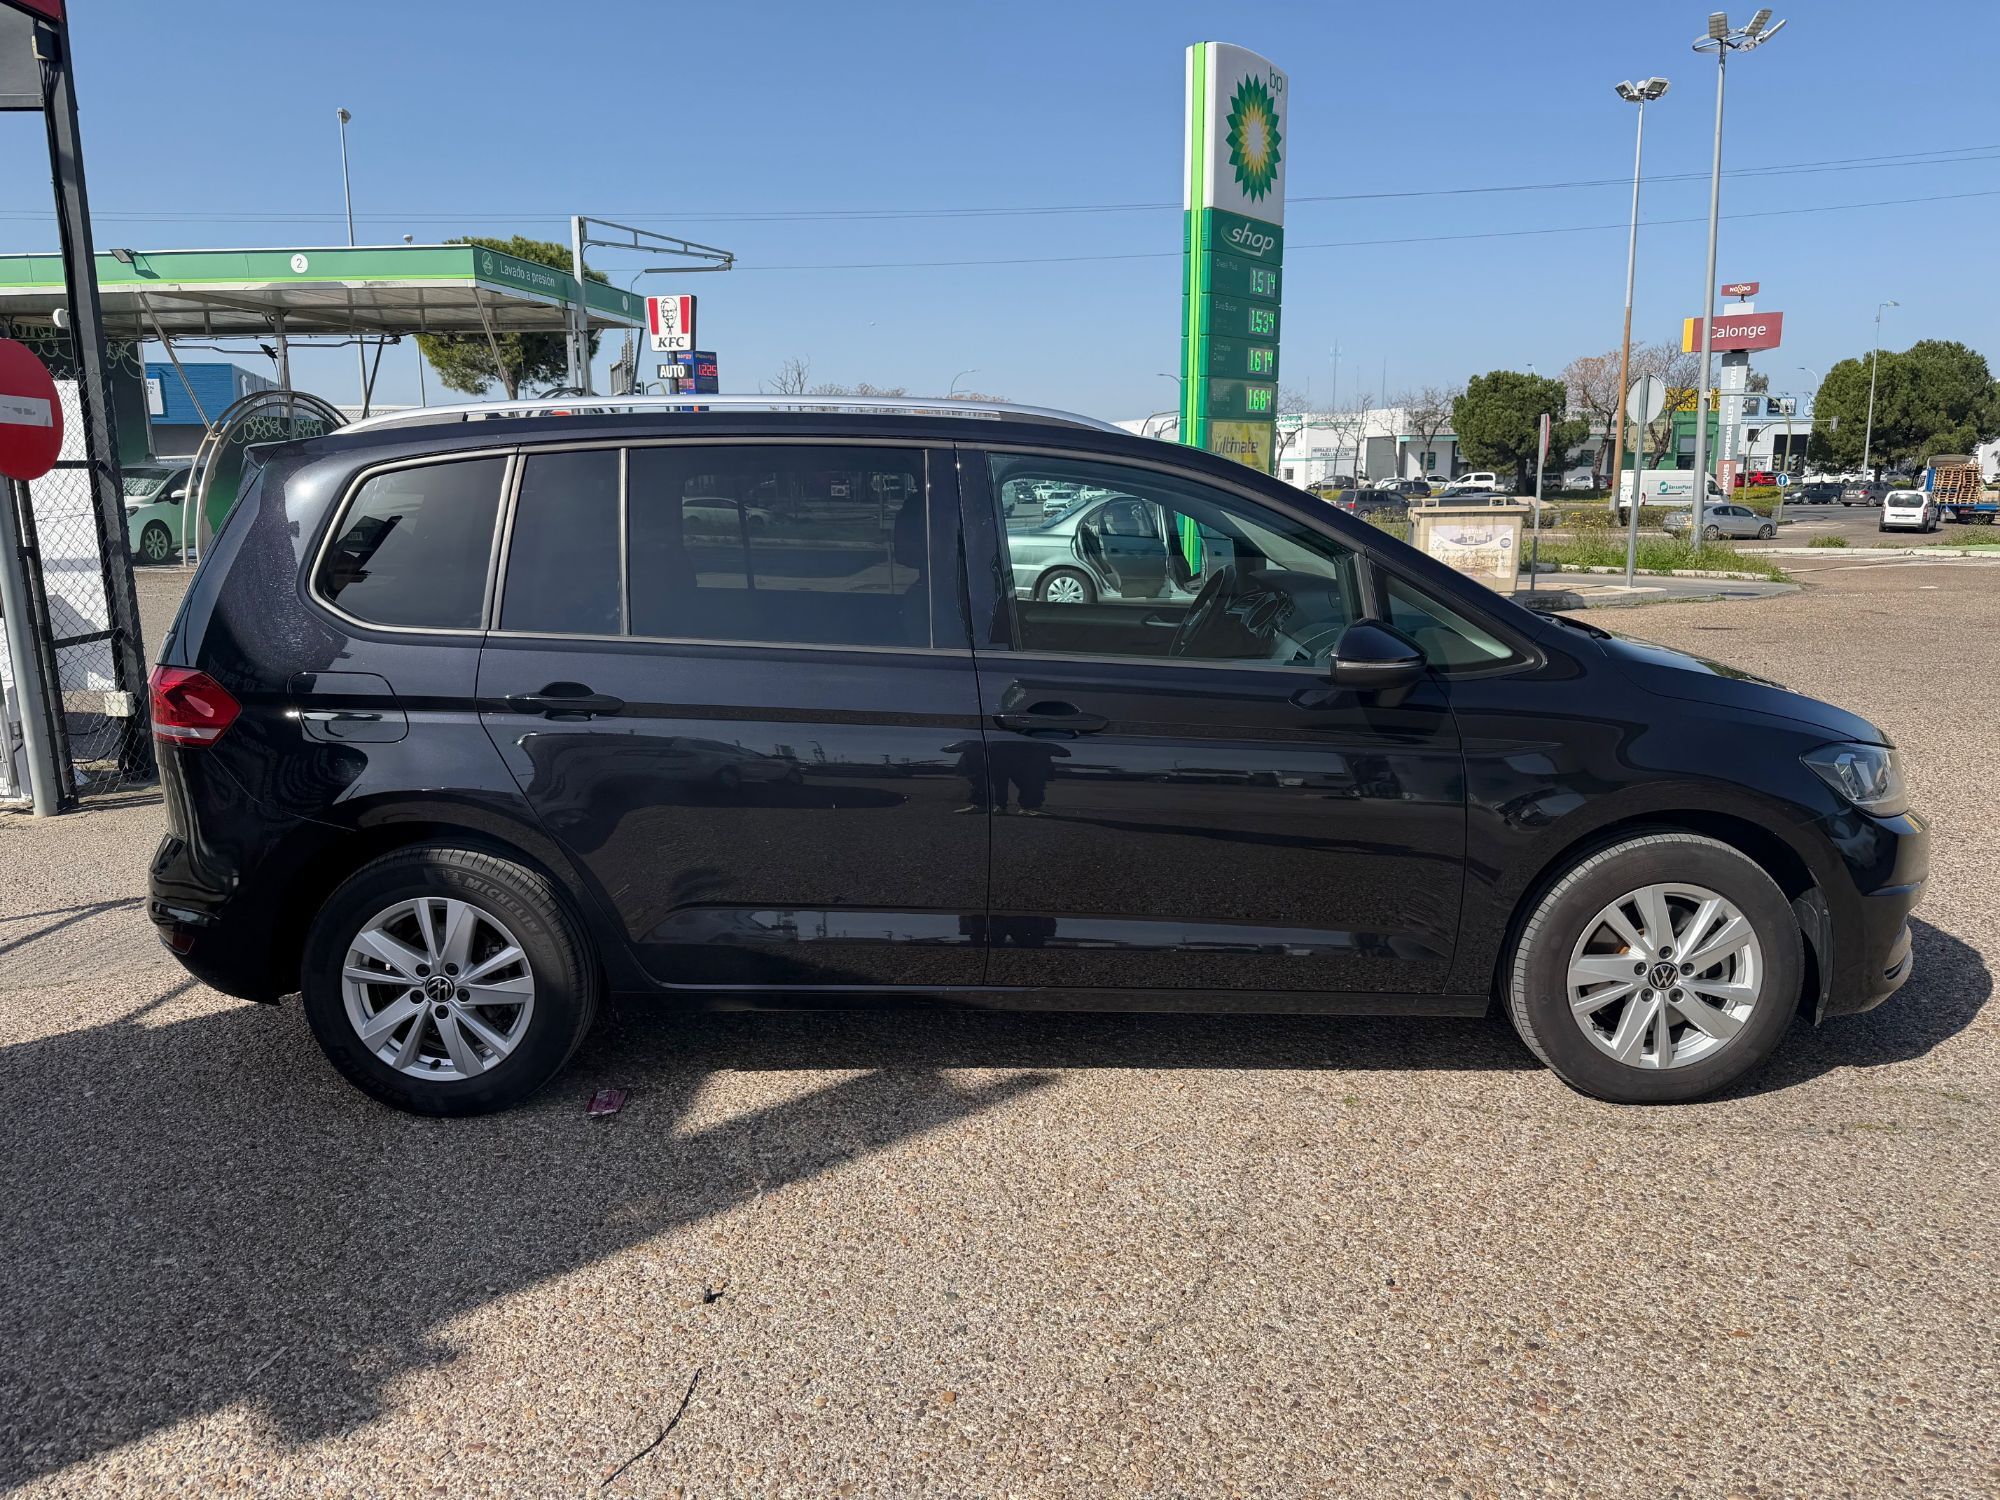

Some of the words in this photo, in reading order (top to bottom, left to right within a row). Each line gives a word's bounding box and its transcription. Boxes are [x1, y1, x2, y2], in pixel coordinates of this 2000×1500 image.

[1269, 66, 1283, 95] bp
[1232, 222, 1274, 256] shop
[296, 257, 303, 269] 2
[499, 260, 525, 280] Lavado
[531, 271, 555, 287] presión
[658, 336, 685, 348] KFC
[1711, 324, 1767, 339] Calonge
[660, 365, 686, 378] AUTO
[1214, 436, 1259, 454] ultimate
[1724, 405, 1734, 461] EMPRESARIALES
[1722, 463, 1731, 495] PARQUES
[464, 877, 540, 935] MICHELIN
